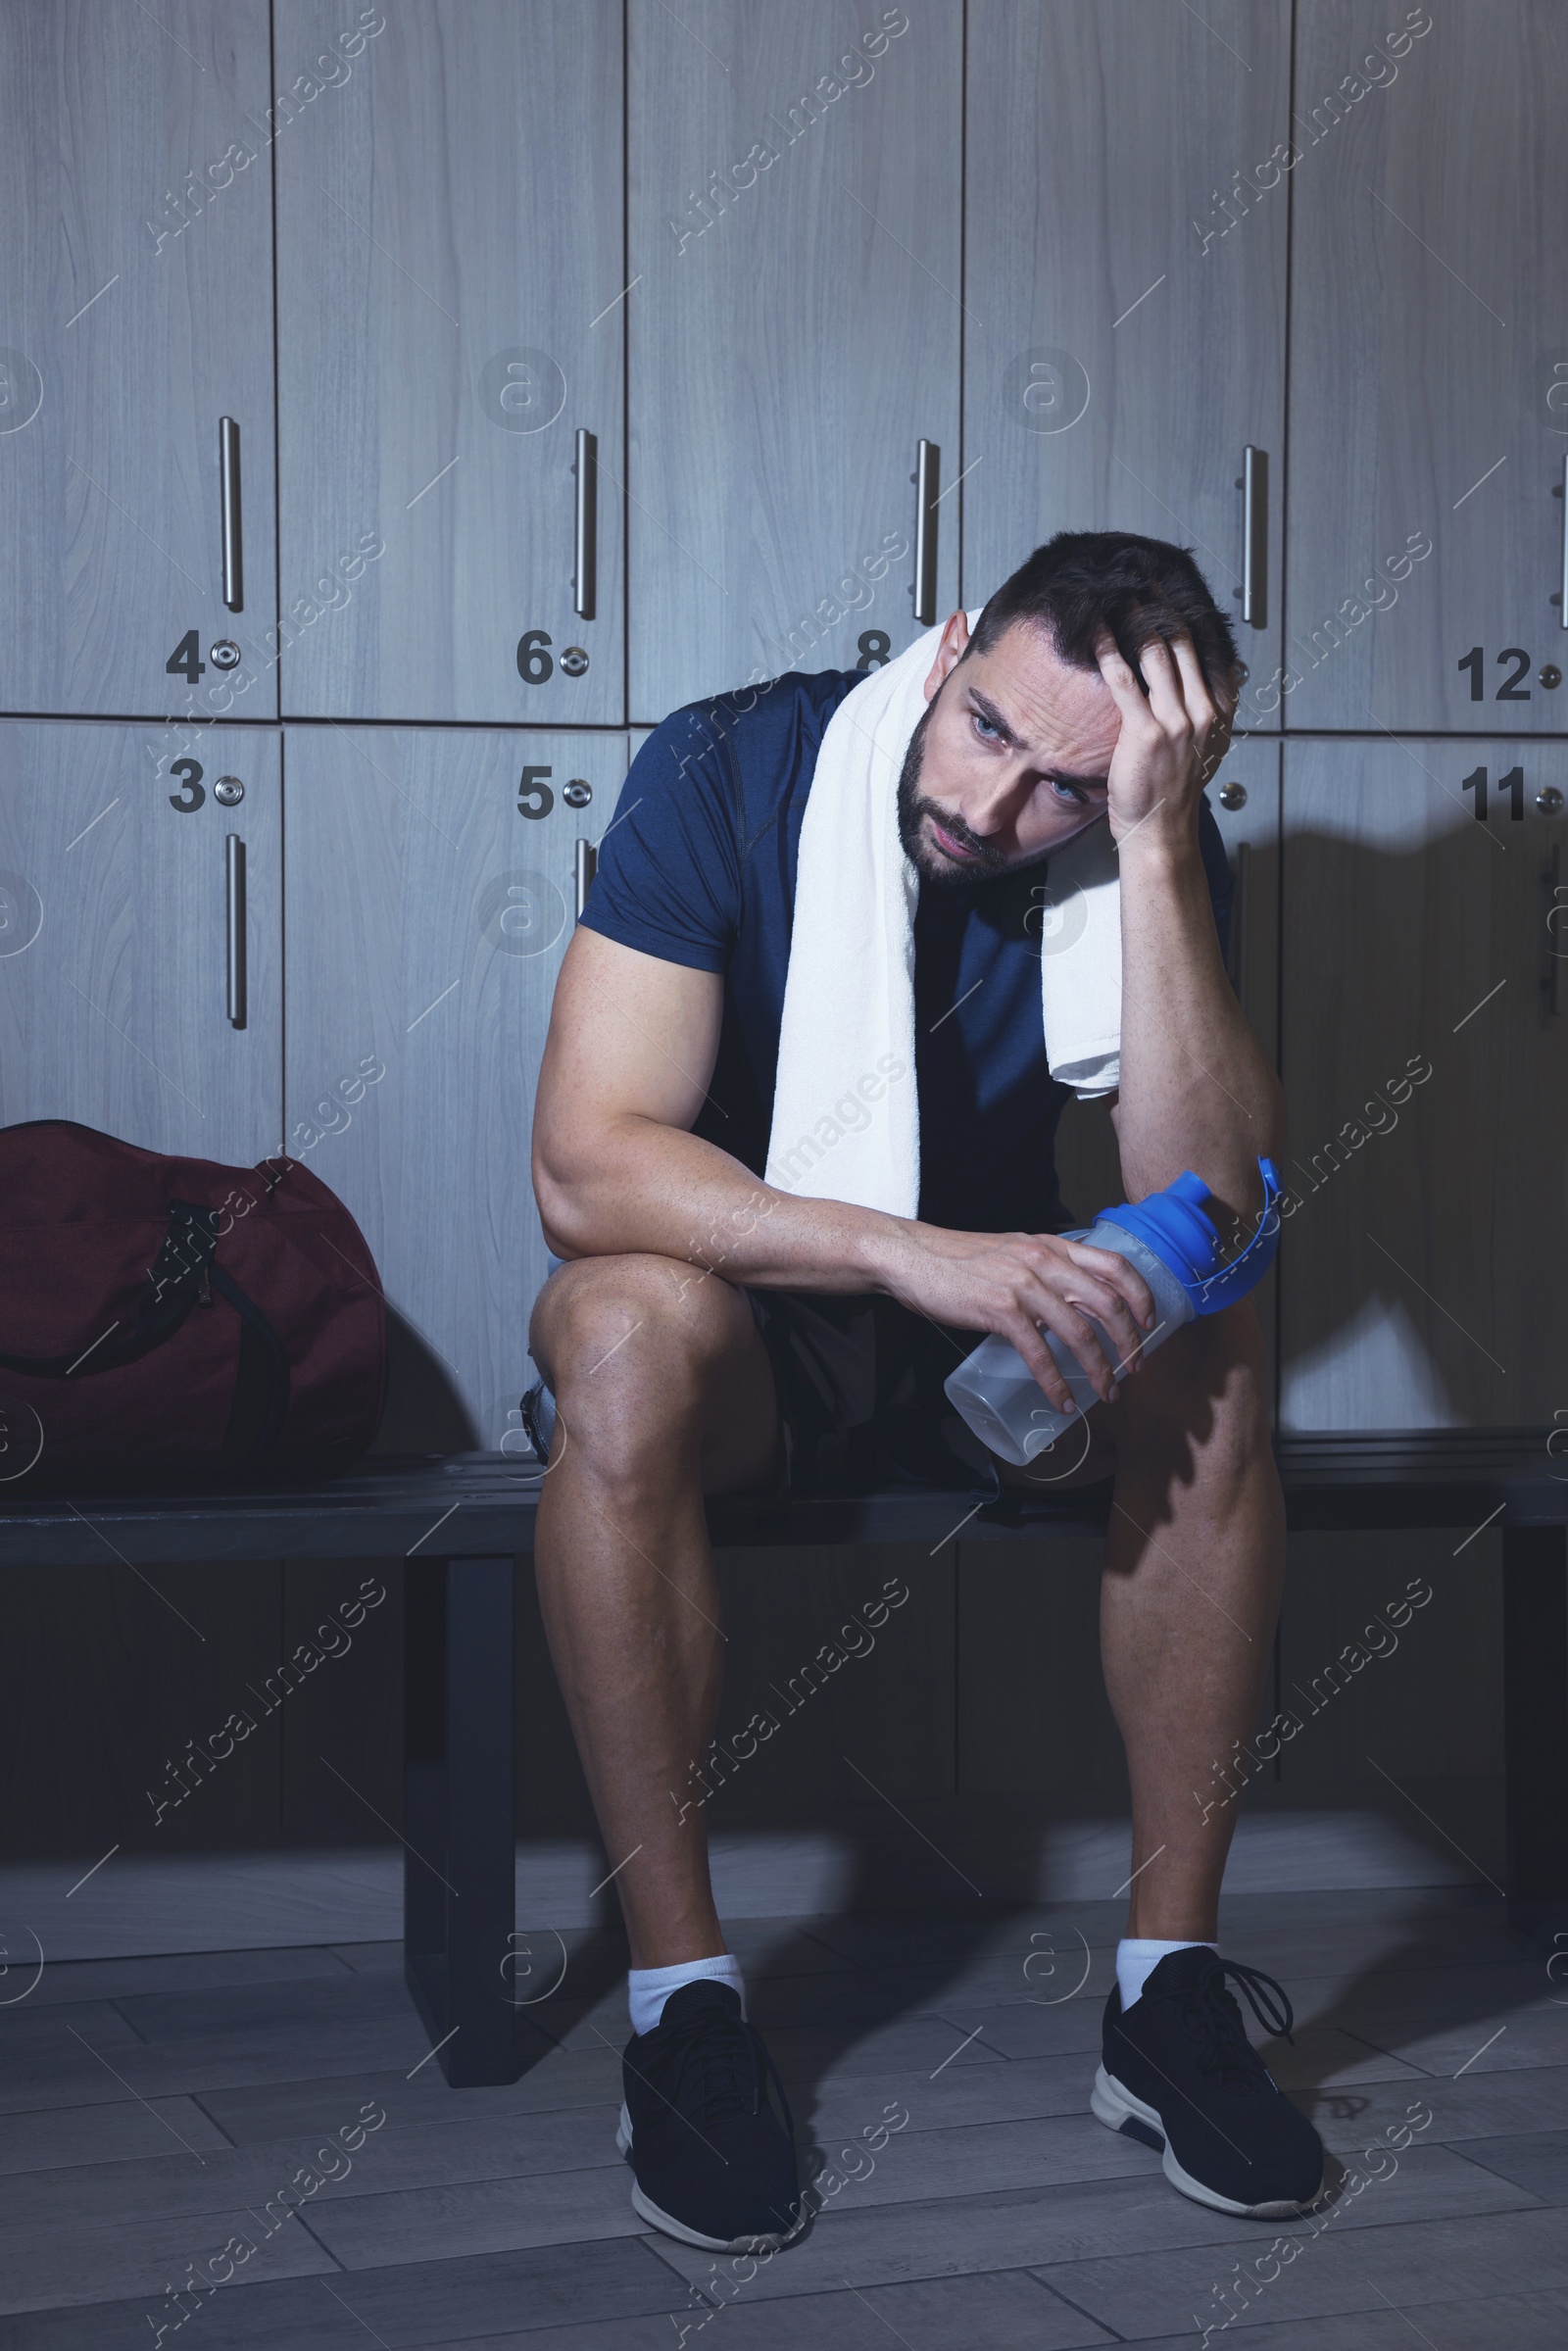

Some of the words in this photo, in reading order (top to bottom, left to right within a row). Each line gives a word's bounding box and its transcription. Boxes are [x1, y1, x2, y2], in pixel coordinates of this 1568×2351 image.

[166, 629, 206, 684] 4
[516, 629, 554, 685] 6
[856, 629, 892, 670] 8
[1457, 647, 1531, 702] 12
[169, 758, 206, 813] 3
[516, 765, 555, 820] 5
[1462, 766, 1524, 821] 11
